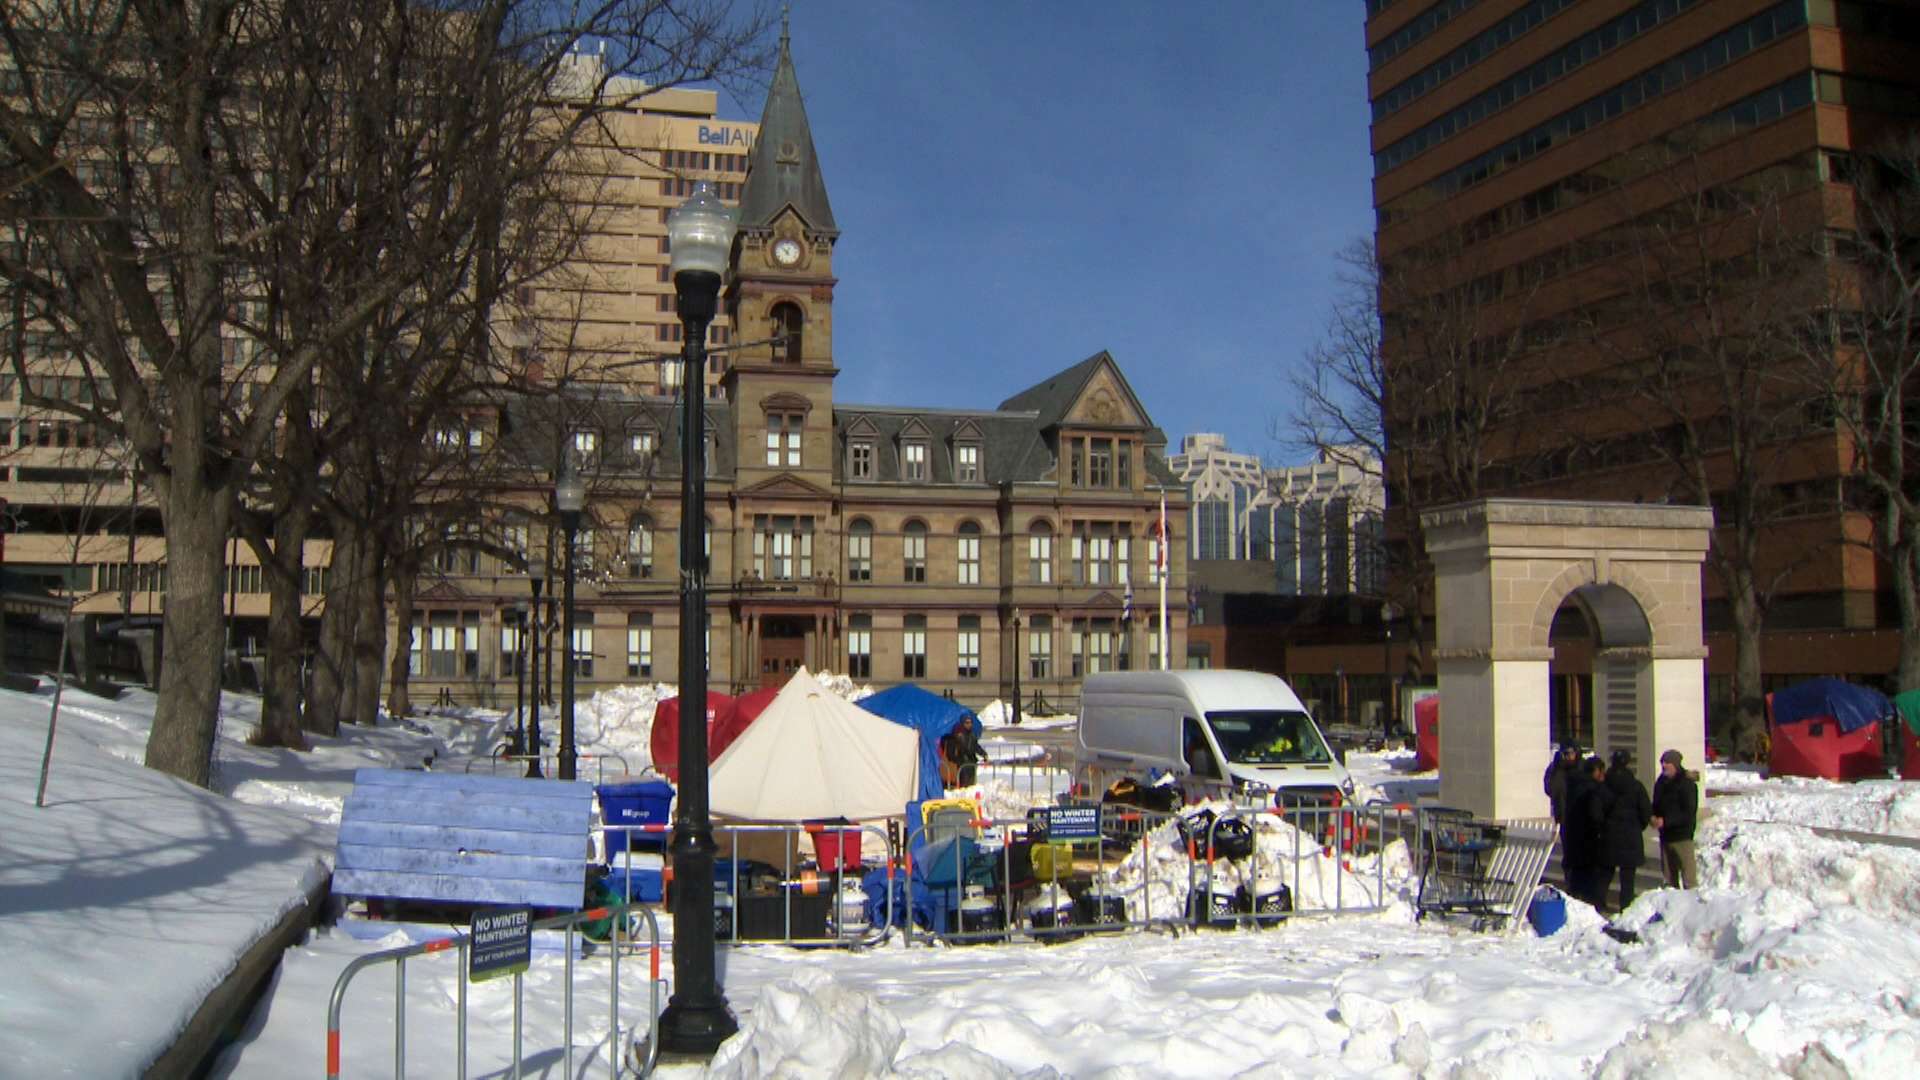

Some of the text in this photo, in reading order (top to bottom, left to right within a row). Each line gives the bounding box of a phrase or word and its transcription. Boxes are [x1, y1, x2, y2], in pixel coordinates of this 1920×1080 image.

[699, 125, 730, 146] Bell
[1050, 816, 1095, 824] MAINTENANCE
[1064, 809, 1096, 817] WINTER
[475, 911, 528, 932] NO WINTER
[475, 925, 527, 944] MAINTENANCE
